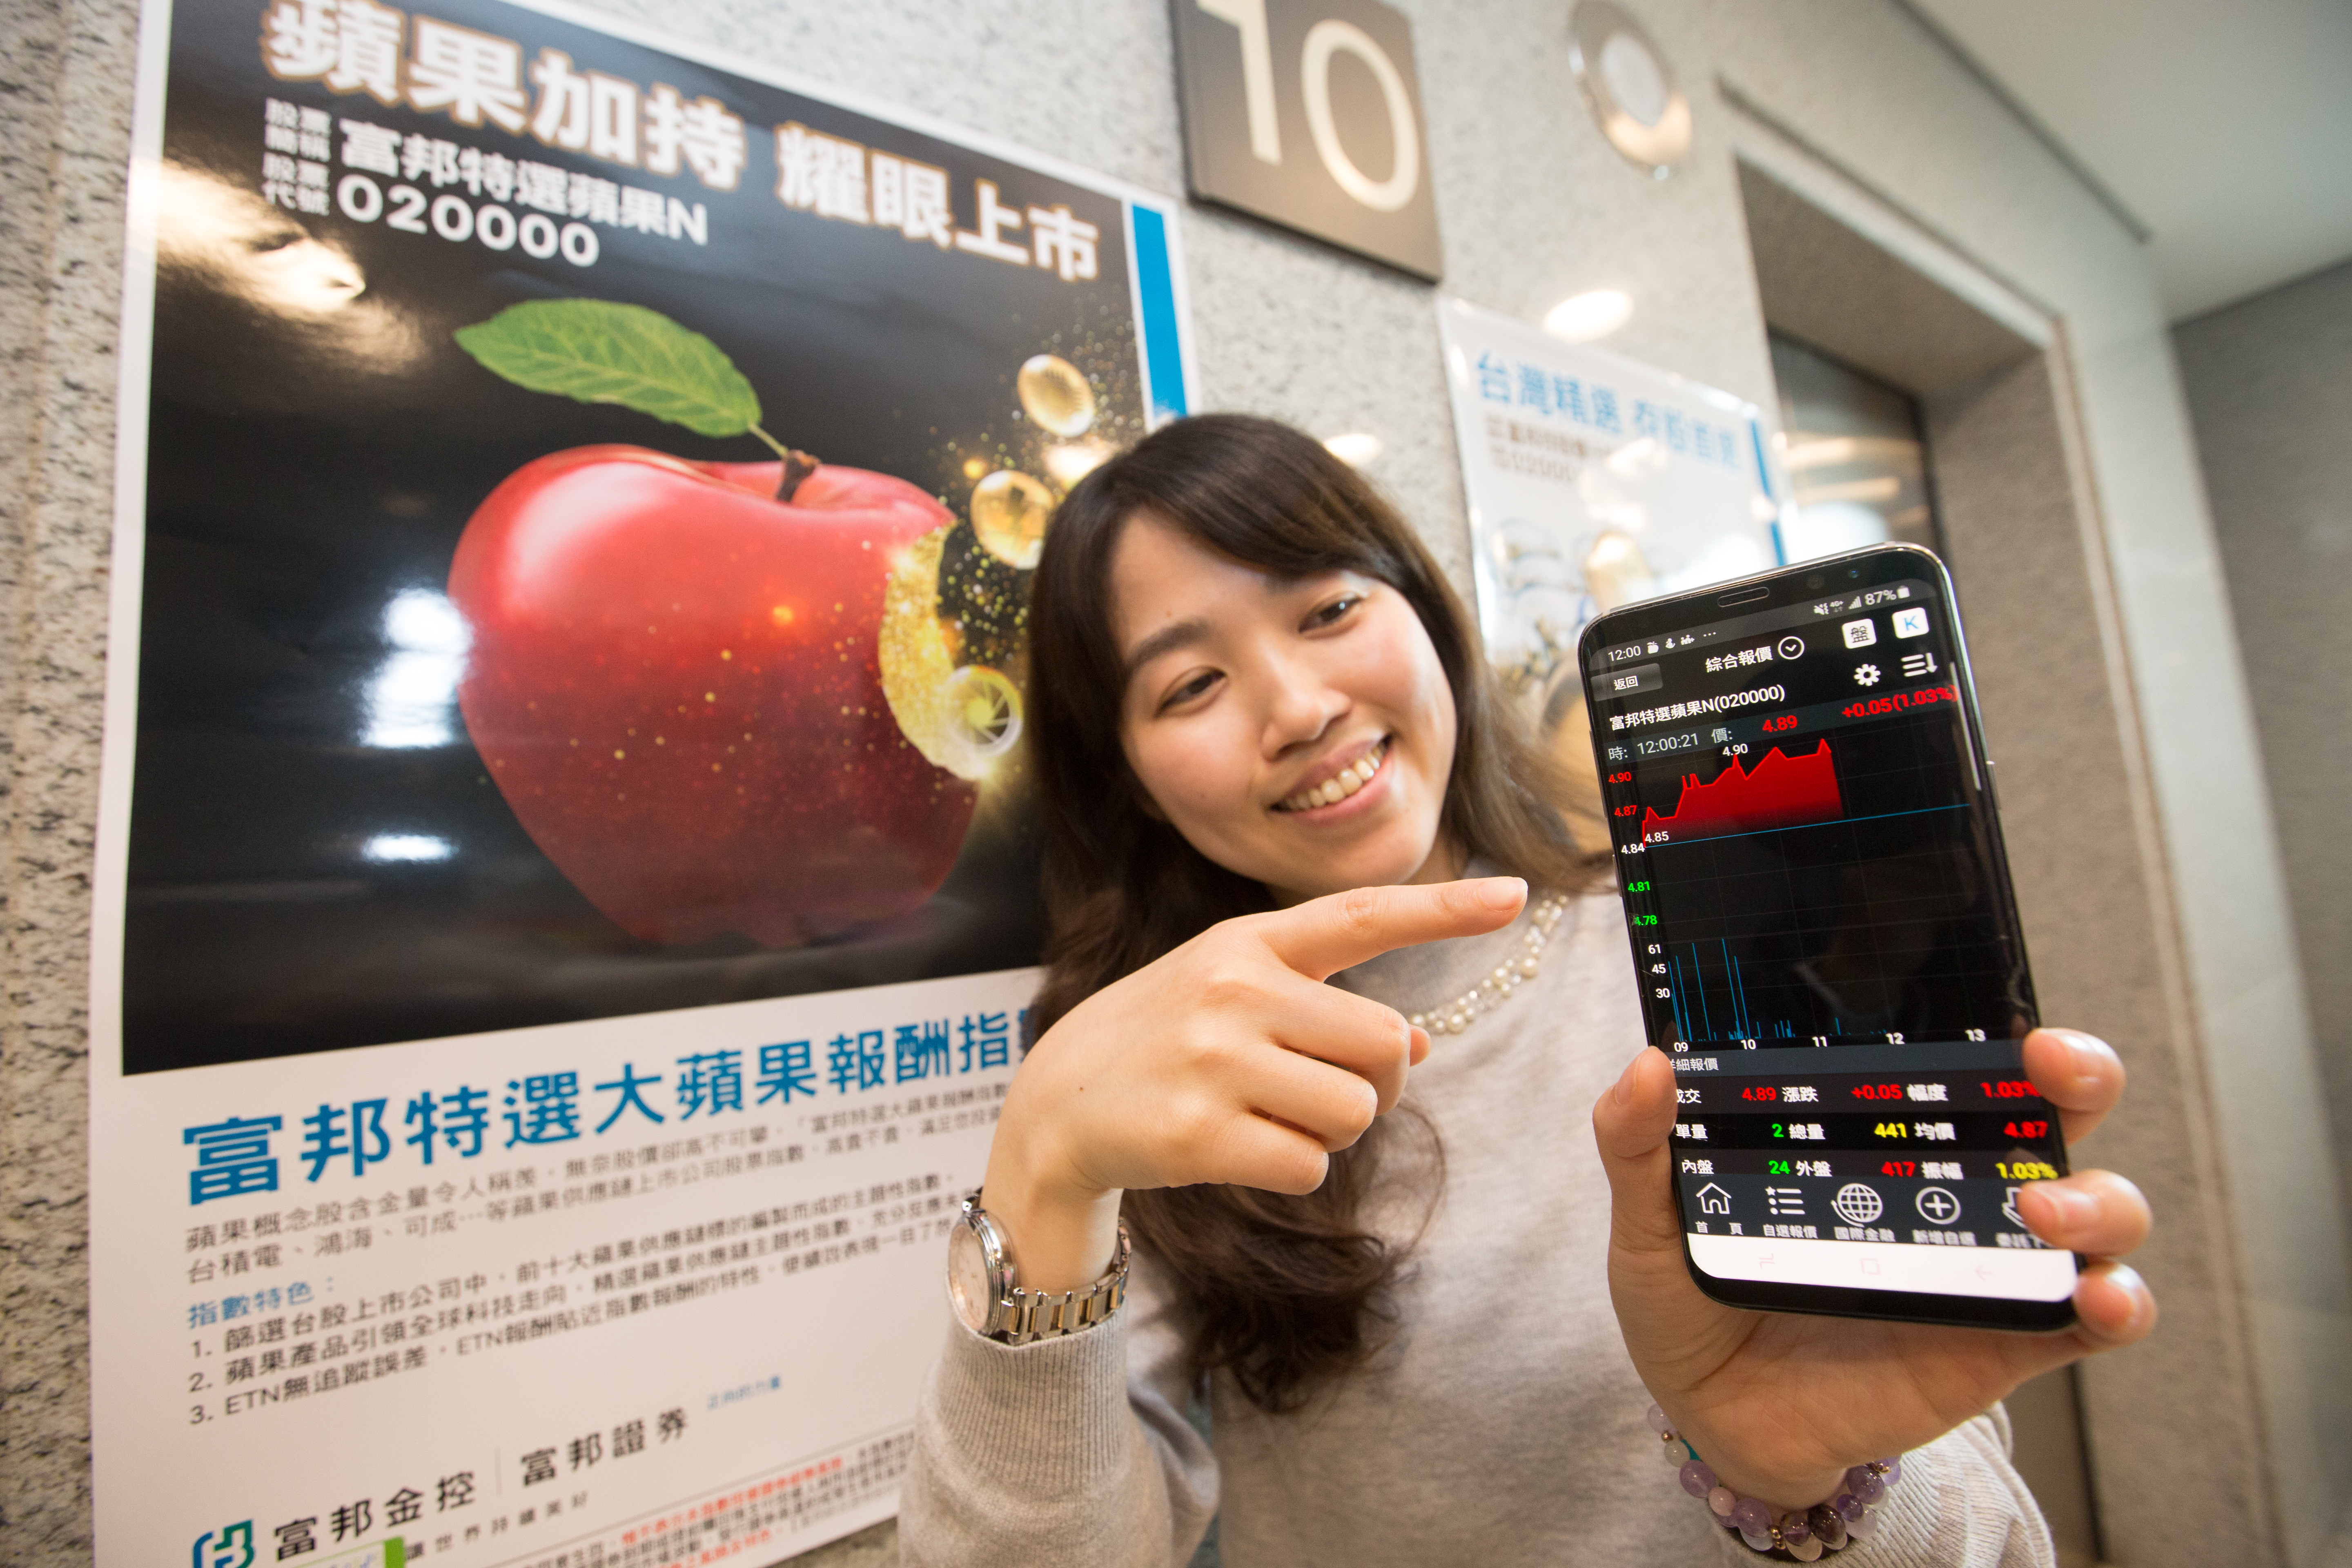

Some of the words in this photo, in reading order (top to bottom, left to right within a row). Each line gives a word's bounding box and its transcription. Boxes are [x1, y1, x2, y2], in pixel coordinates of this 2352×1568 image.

[1196, 0, 1420, 212] 10
[262, 0, 746, 191] 蘋果加持
[775, 120, 1099, 282] 耀眼上市
[339, 118, 708, 245] 富邦特選蘋果N
[337, 175, 599, 267] 020000
[1864, 590, 1897, 605] 87%
[1904, 615, 1920, 631] K
[1851, 626, 1870, 643] 盤
[1608, 646, 1642, 662] 12:00
[1705, 646, 1773, 673] 綜合報價
[1613, 675, 1639, 690] 返回
[1609, 684, 1785, 731] 富邦特選蘋果N(020000)
[1608, 746, 1628, 761] 時:
[1637, 733, 1699, 755] 12:00:21
[1711, 728, 1733, 744] 價:
[1762, 715, 1797, 733] 4.89
[1842, 684, 1959, 717] +0.05(1.03%)
[1722, 743, 1748, 757] 4.90
[1608, 772, 1631, 783] 4.90
[1614, 805, 1637, 817] 4.87
[1645, 831, 1669, 843] 4.85
[1621, 842, 1645, 854] 4.84
[1628, 881, 1650, 892] 4.81
[1635, 915, 1657, 926] 4.78
[1648, 944, 1661, 955] 61
[1652, 964, 1666, 975] 45
[1655, 988, 1670, 999] 30
[1674, 1042, 1688, 1052] 09
[1741, 1039, 1756, 1050] 10
[1811, 1036, 1828, 1047] 11
[1886, 1032, 1905, 1045] 12
[1965, 1029, 1987, 1042] 13
[1742, 1087, 1776, 1101] 4.89
[1782, 1086, 1819, 1102] 漲跌
[1851, 1084, 1903, 1100] +0.05
[1907, 1083, 1949, 1101] 幅度
[1675, 1124, 1708, 1139] 單量
[1772, 1123, 1784, 1138] 2
[1788, 1123, 1826, 1140] 總量
[1874, 1122, 1907, 1138] 441
[1914, 1122, 1957, 1140] 均價
[2003, 1120, 2048, 1138] 4.87
[1682, 1159, 1715, 1175] 內盤
[1768, 1160, 1791, 1174] 24
[1795, 1160, 1833, 1177] 外盤
[1881, 1161, 1915, 1177] 417
[1921, 1161, 1964, 1180] 振幅
[1995, 1162, 2058, 1180] 1.03%
[1762, 1224, 1818, 1239] 自選報價
[191, 1340, 212, 1359] 1.
[188, 1372, 213, 1393] 2.
[189, 1404, 214, 1425] 3.
[274, 1471, 475, 1562] 富邦金控
[521, 1407, 687, 1488] 富邦證券
